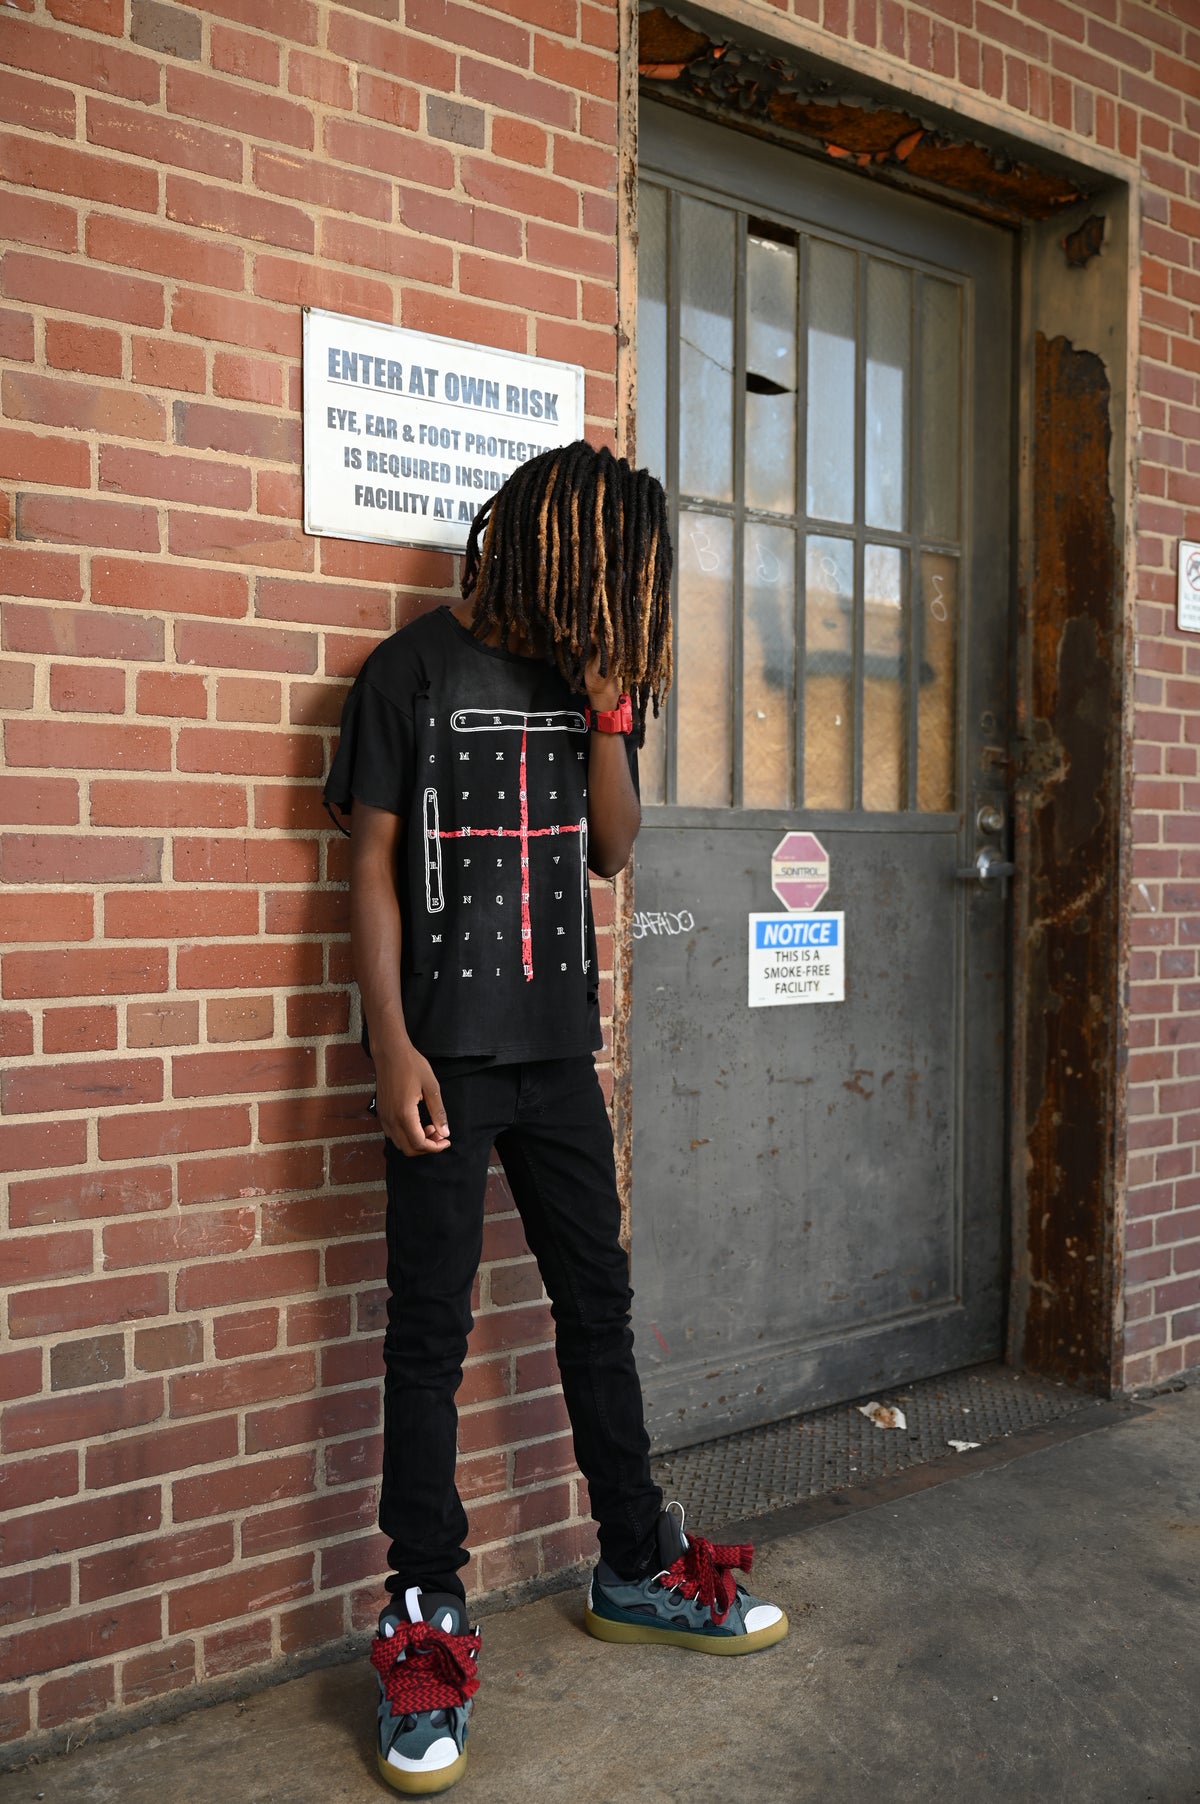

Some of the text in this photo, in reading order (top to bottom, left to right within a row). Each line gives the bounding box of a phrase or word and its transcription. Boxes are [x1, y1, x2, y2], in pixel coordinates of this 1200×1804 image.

[328, 347, 558, 420] ENTER AT OWN RISK
[327, 407, 361, 436] EYE,
[366, 414, 398, 440] EAR
[402, 424, 415, 442] &
[419, 424, 460, 451] FOOT
[344, 446, 362, 470] IS
[367, 452, 451, 484] REQUIRED
[355, 484, 430, 516] FACILITY
[434, 497, 454, 520] AT
[459, 752, 470, 761] M
[496, 752, 504, 761] X
[461, 827, 471, 837] N
[550, 825, 560, 836] N
[521, 857, 530, 868] N
[781, 867, 820, 876] SONITROL
[463, 895, 472, 904] N
[496, 895, 504, 905] Q
[554, 891, 563, 900] U
[432, 934, 442, 943] M
[496, 931, 503, 940] L
[521, 928, 532, 939] U
[764, 922, 831, 946] NOTICE
[775, 949, 821, 963] THIS IS A
[462, 969, 473, 978] M
[764, 964, 830, 980] SMOKE-FREE
[774, 980, 820, 994] FACILITY
